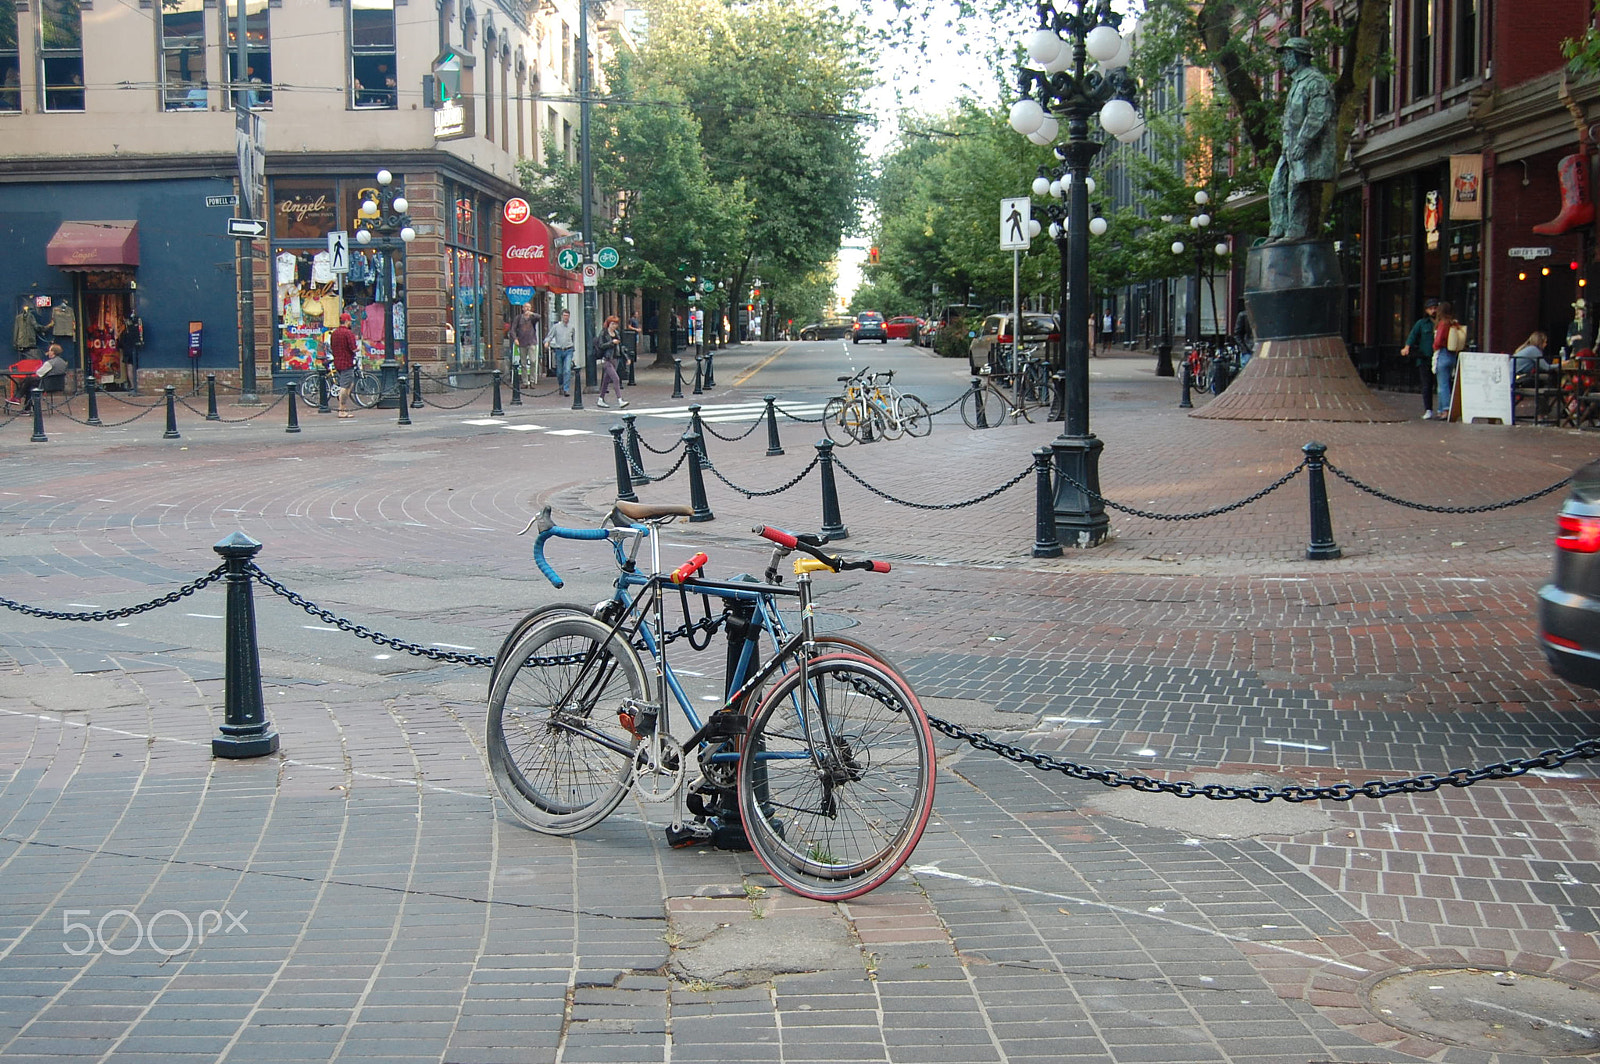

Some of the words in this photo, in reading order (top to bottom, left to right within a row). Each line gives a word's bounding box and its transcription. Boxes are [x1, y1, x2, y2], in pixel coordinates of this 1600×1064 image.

[208, 197, 228, 206] POWELL
[291, 326, 321, 335] Desigual
[370, 347, 402, 356] Desal
